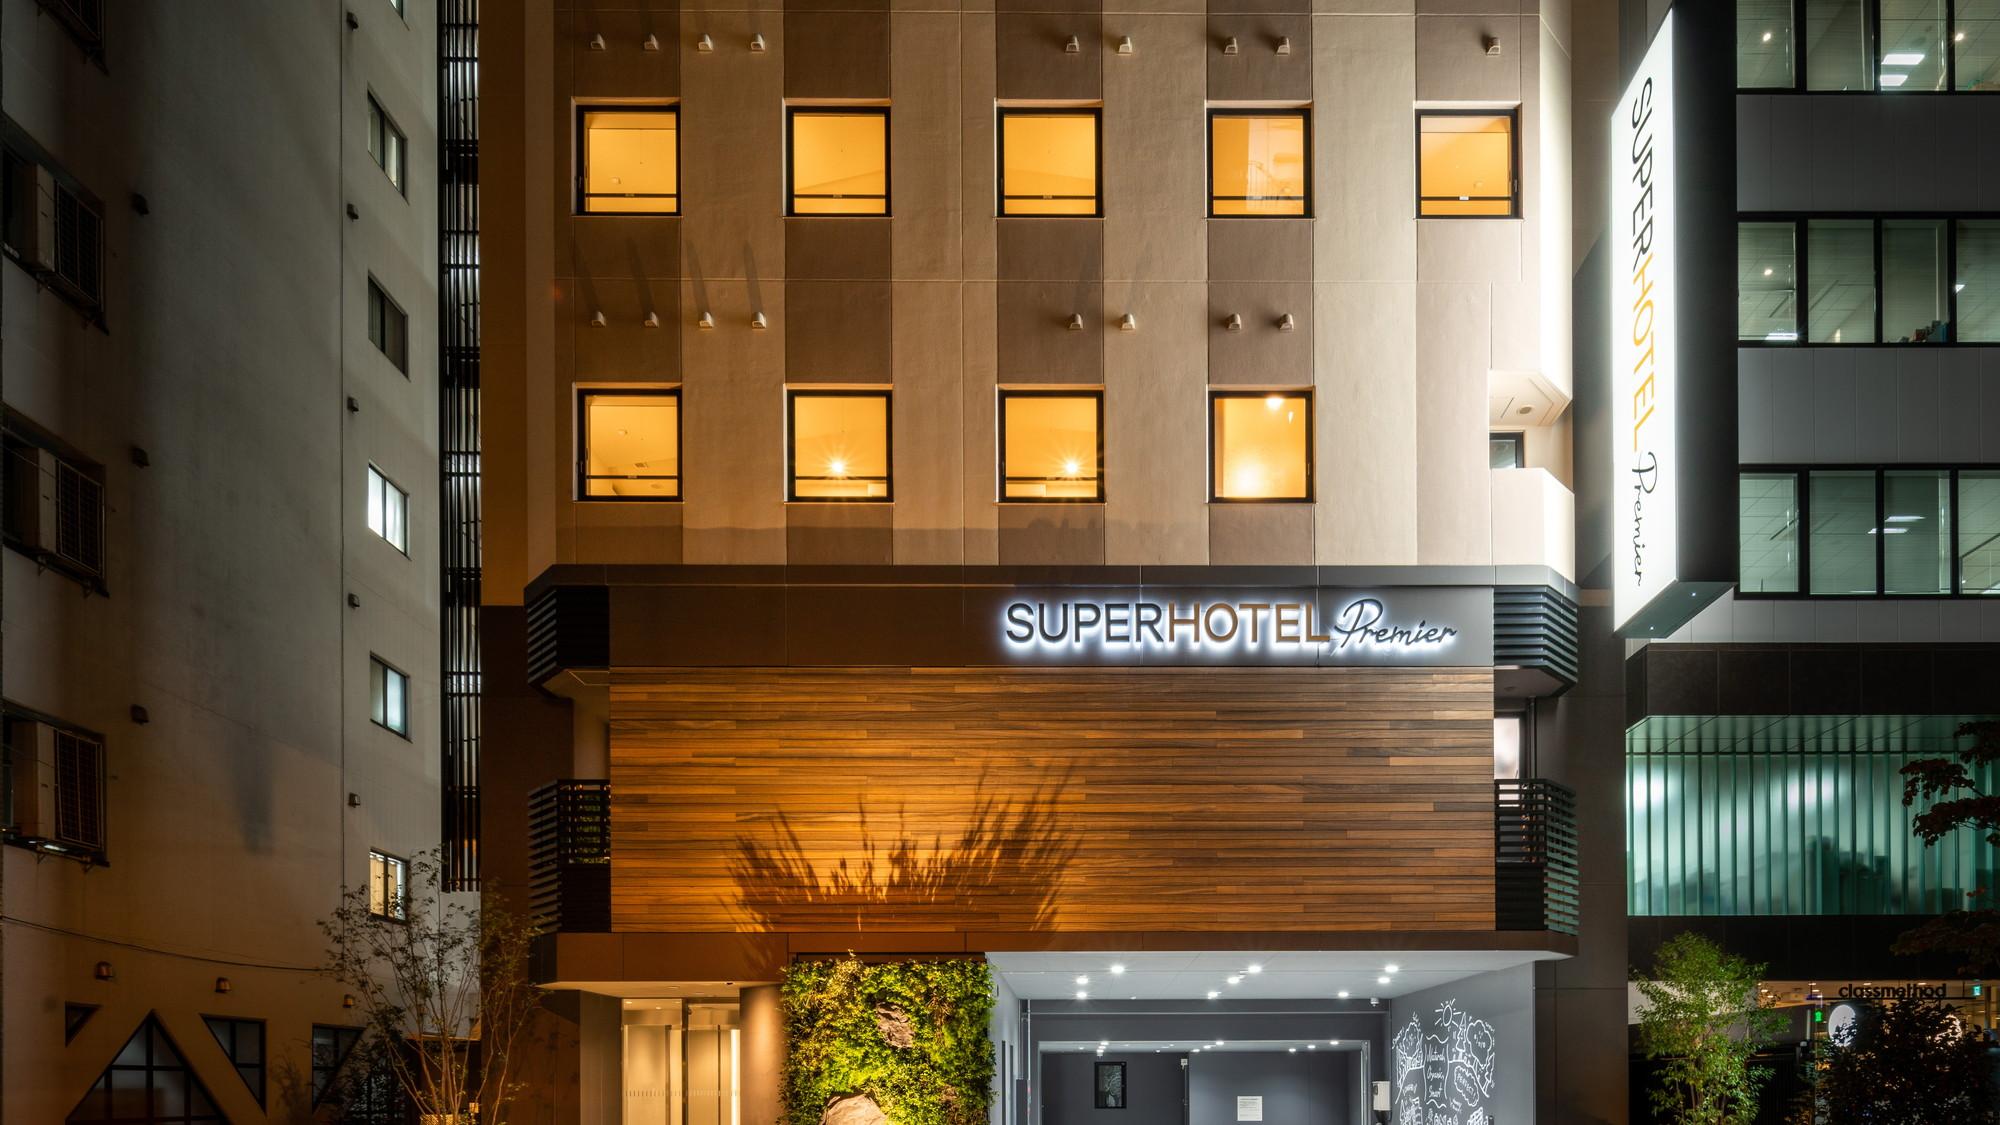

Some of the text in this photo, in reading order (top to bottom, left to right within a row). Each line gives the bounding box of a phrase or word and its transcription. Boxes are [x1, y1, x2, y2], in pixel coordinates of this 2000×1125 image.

[1632, 76, 1658, 587] SUPERHOTEL Premier
[1006, 598, 1457, 649] SUPERHOTEL Premier
[1838, 983, 1947, 998] classmethod
